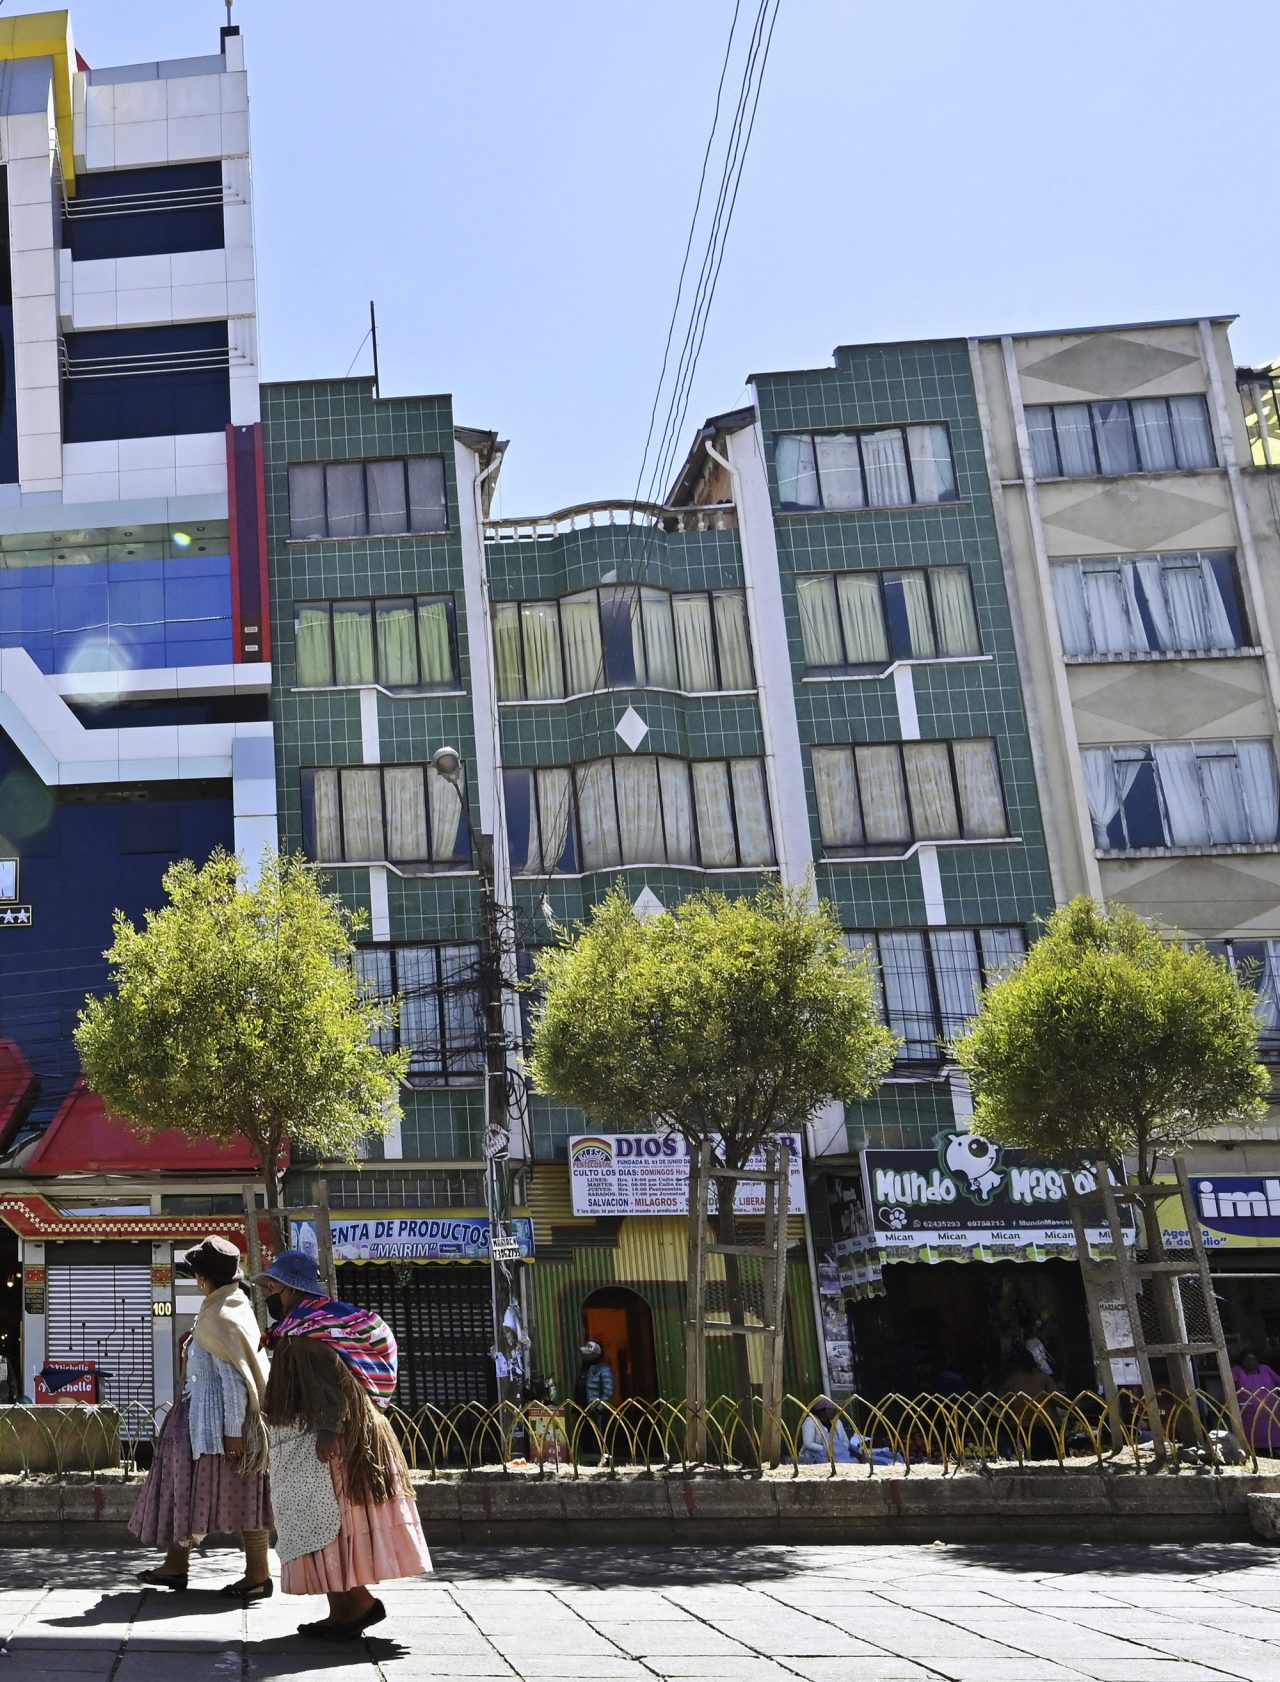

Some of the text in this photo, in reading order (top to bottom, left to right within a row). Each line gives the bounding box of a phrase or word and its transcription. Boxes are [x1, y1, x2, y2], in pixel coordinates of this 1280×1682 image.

[615, 1138, 677, 1158] DIOS
[573, 1169, 600, 1177] CULTO
[601, 1169, 616, 1177] LOS
[875, 1169, 957, 1205] Mundo
[588, 1198, 629, 1207] SALVACION
[634, 1198, 678, 1207] MILAGROS
[331, 1220, 490, 1248] ENTA DE PRODUCTOS
[885, 1233, 914, 1241] Mican
[937, 1232, 967, 1241] Mican
[991, 1231, 1020, 1240] Mican
[1044, 1231, 1074, 1239] Mican
[1098, 1230, 1129, 1239] Min
[152, 1302, 172, 1316] 100
